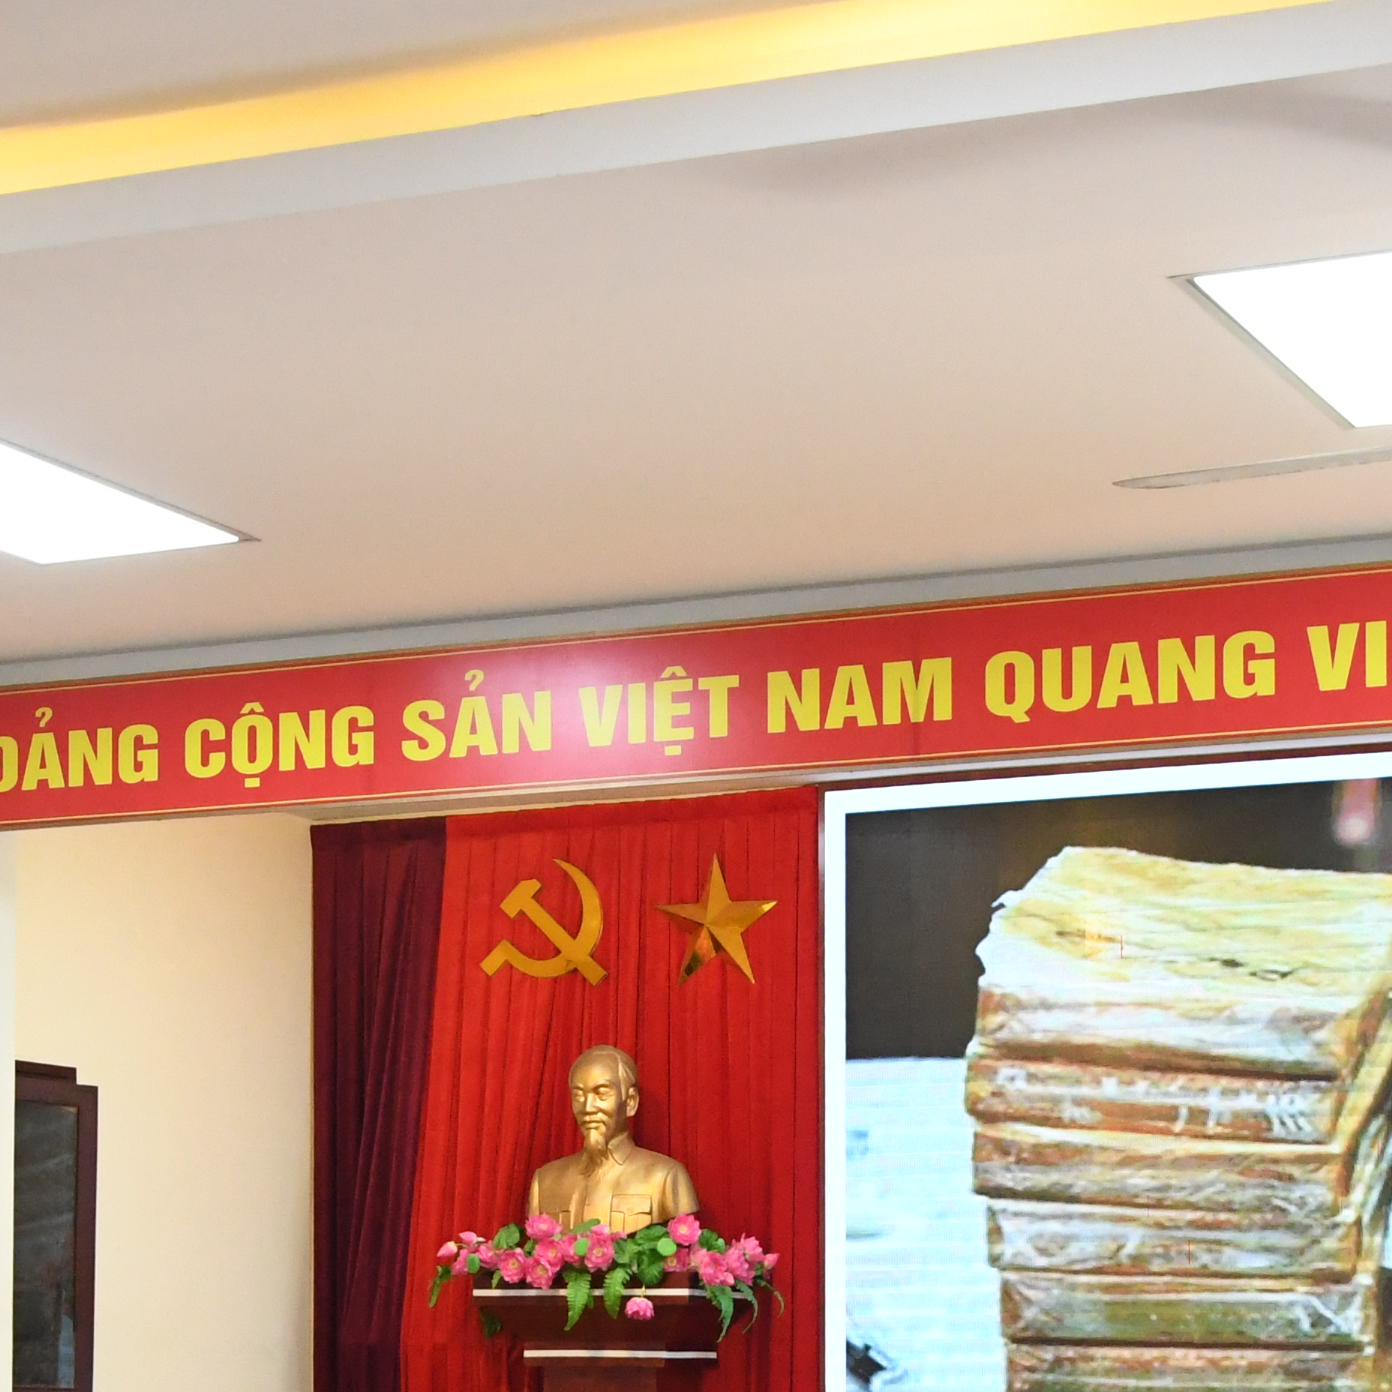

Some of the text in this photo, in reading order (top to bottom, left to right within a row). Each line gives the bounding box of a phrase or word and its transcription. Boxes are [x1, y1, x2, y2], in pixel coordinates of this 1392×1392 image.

[185, 702, 374, 788] CỘNG
[402, 670, 552, 761] SẢN
[580, 666, 739, 755] VIỆT
[767, 657, 952, 733] NAM
[985, 631, 1275, 723] QUANG
